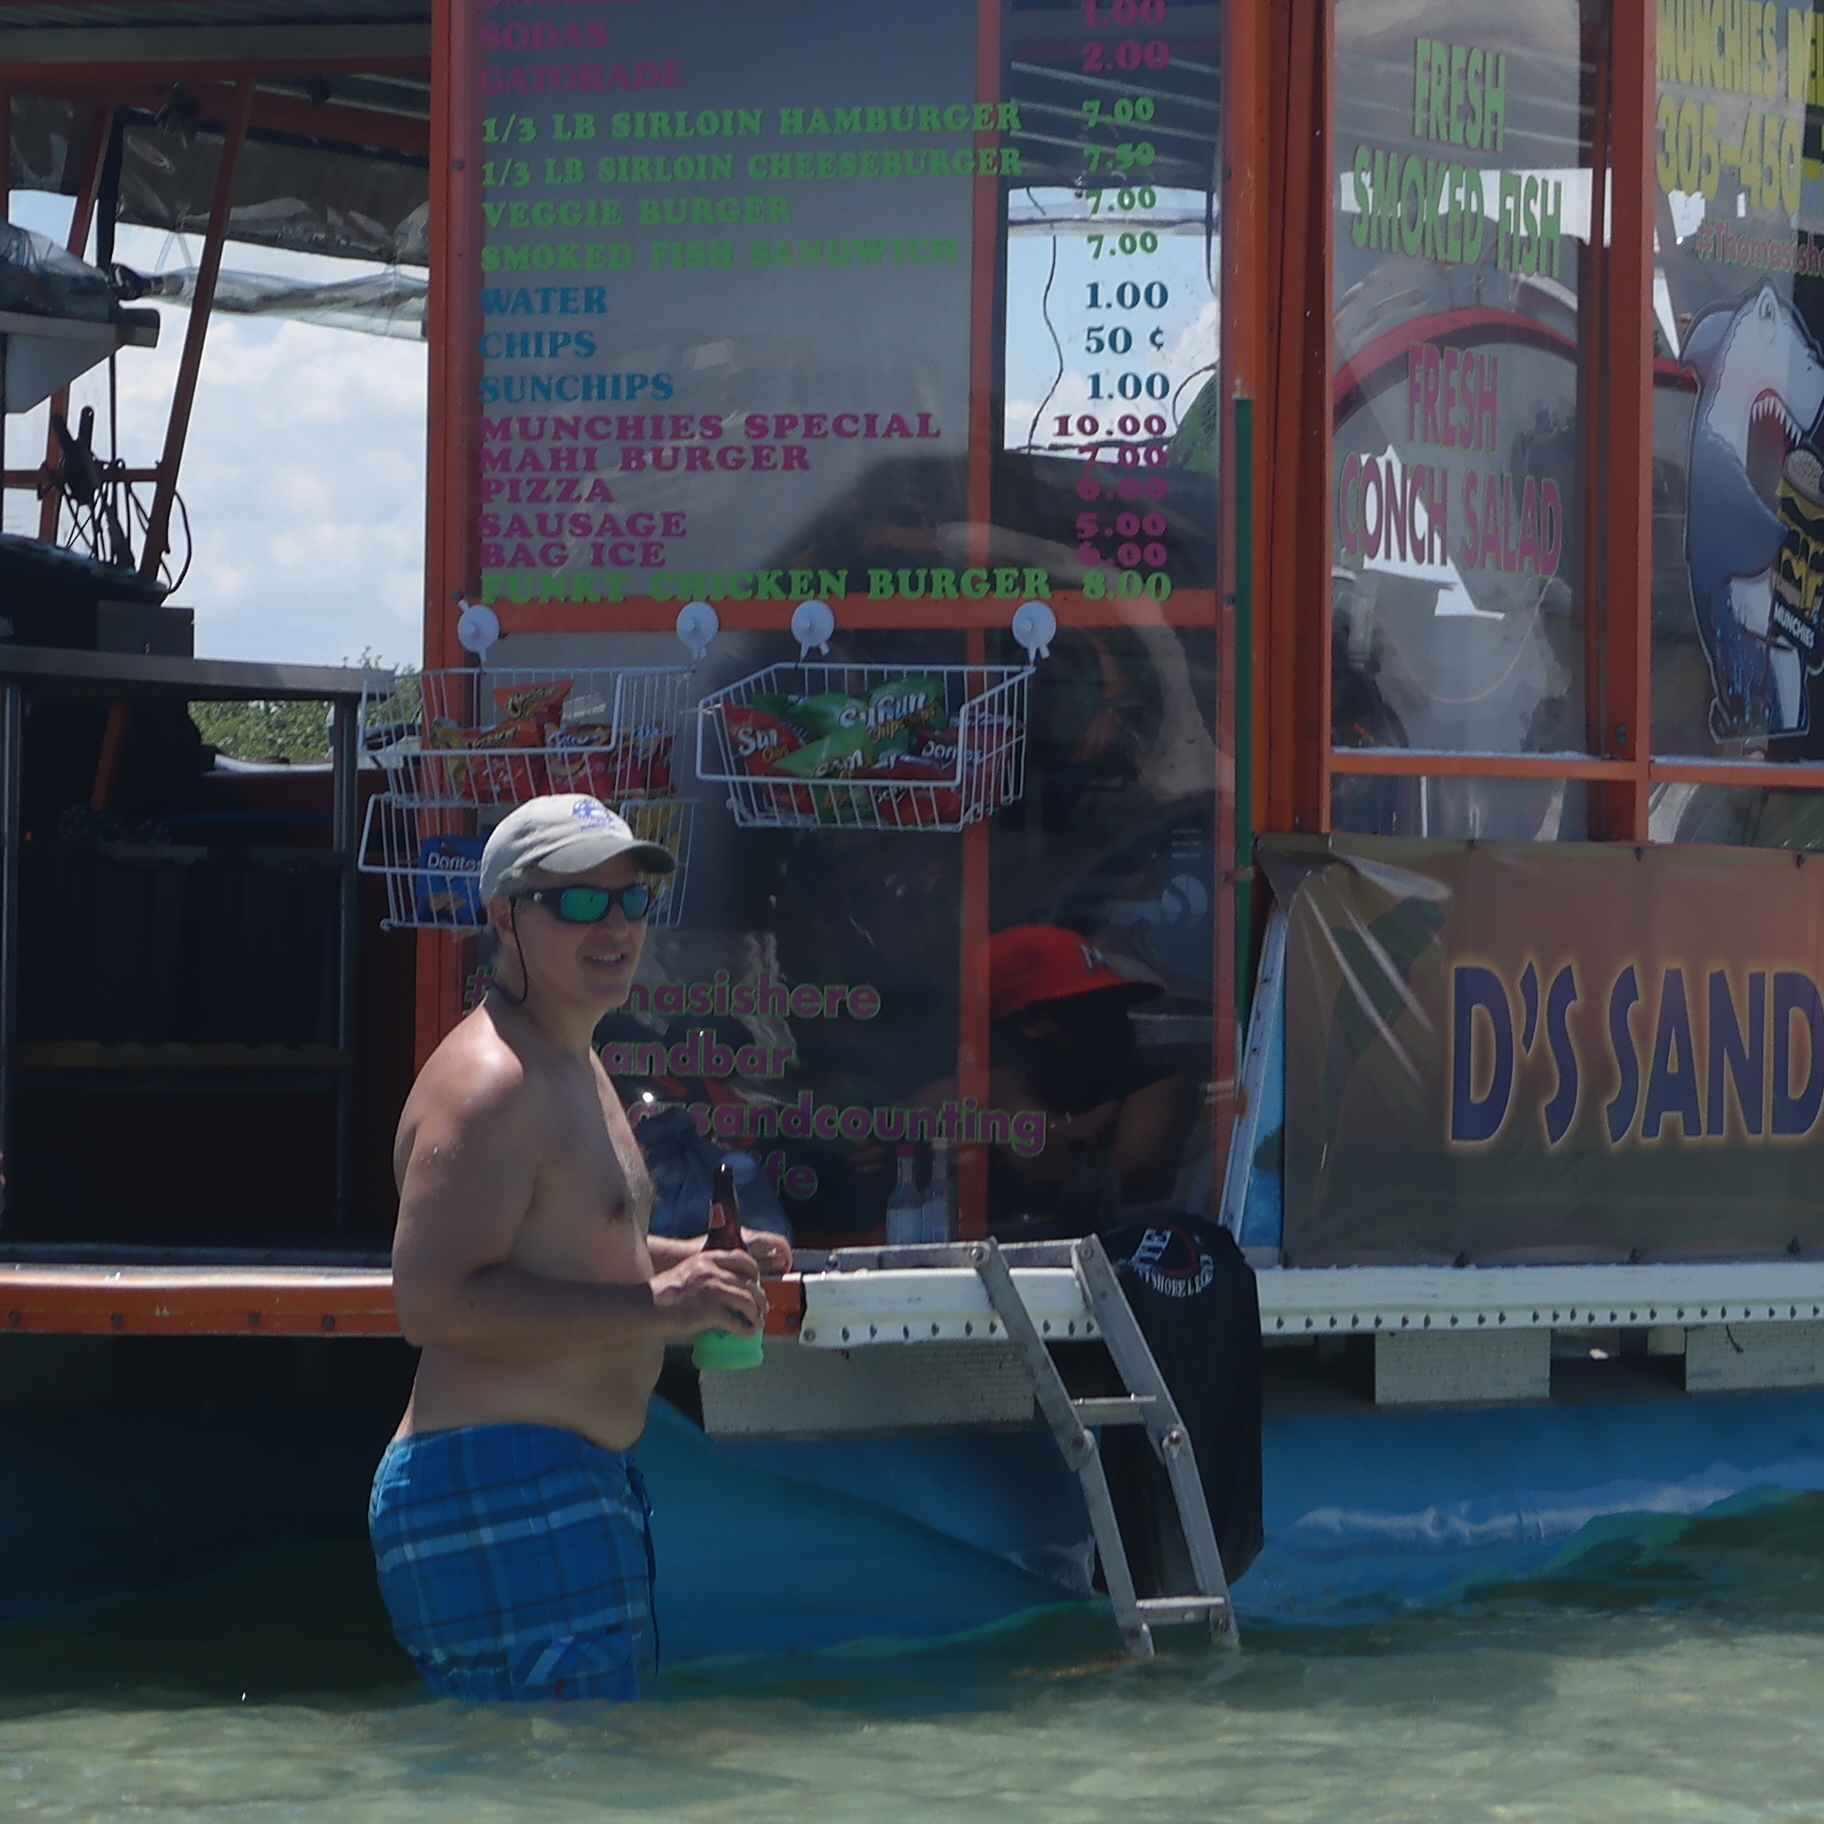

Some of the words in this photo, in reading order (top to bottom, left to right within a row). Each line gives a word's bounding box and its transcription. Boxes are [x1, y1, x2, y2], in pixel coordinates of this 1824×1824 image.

[479, 18, 611, 52] SODAS
[479, 58, 687, 97] GATORADE
[1082, 38, 1172, 73] 2.00
[1414, 37, 1507, 153] FRESH
[482, 115, 537, 144] 1/3
[551, 112, 597, 142] LB
[611, 107, 764, 139] SIRLOIN
[778, 102, 1023, 135] HAMBURGER
[1082, 96, 1156, 130] 7.00
[481, 159, 532, 188] 1/3
[544, 156, 585, 186] LB
[598, 152, 734, 185] SIRLOIN
[747, 146, 1023, 180] CHEESEBURGER
[1082, 141, 1157, 173] 7.50
[482, 200, 623, 228] VEGGIE
[638, 196, 794, 226] BURGER
[1083, 185, 1158, 217] 7.00
[1350, 144, 1485, 266] SMOKED
[1496, 172, 1562, 280] FISH
[481, 242, 634, 273] SMOKED
[649, 239, 735, 270] FISH
[750, 235, 960, 268] SANDWICH
[1085, 233, 1159, 260] 7.00
[480, 285, 608, 316] WATER
[1084, 279, 1170, 312] 1.00
[479, 329, 597, 361] CHIPS
[1083, 324, 1133, 356] 50
[479, 372, 675, 405] SUNCHIPS
[1085, 370, 1171, 403] 1.00
[1406, 341, 1499, 456] FRESH
[480, 413, 725, 444] MUNCHIES
[742, 410, 943, 441] SPECIAL
[1052, 411, 1167, 439] 10.00
[480, 446, 598, 474] MAHI
[620, 443, 812, 472] BURGER
[1076, 443, 1169, 472] 7.00
[480, 477, 616, 504] PIZZA
[480, 510, 688, 540] SAUSAGE
[1339, 450, 1449, 568] CONCH
[1461, 468, 1563, 579] SALAD
[480, 542, 569, 568] BAG
[589, 541, 667, 568] ICE
[480, 574, 627, 605] FUNKY
[648, 568, 850, 603] CHICKEN
[867, 568, 1052, 602] BURGER
[1081, 566, 1173, 603] 8.00
[874, 691, 927, 723] Sun
[735, 724, 779, 759] Sun
[1450, 960, 1579, 1146] D'S
